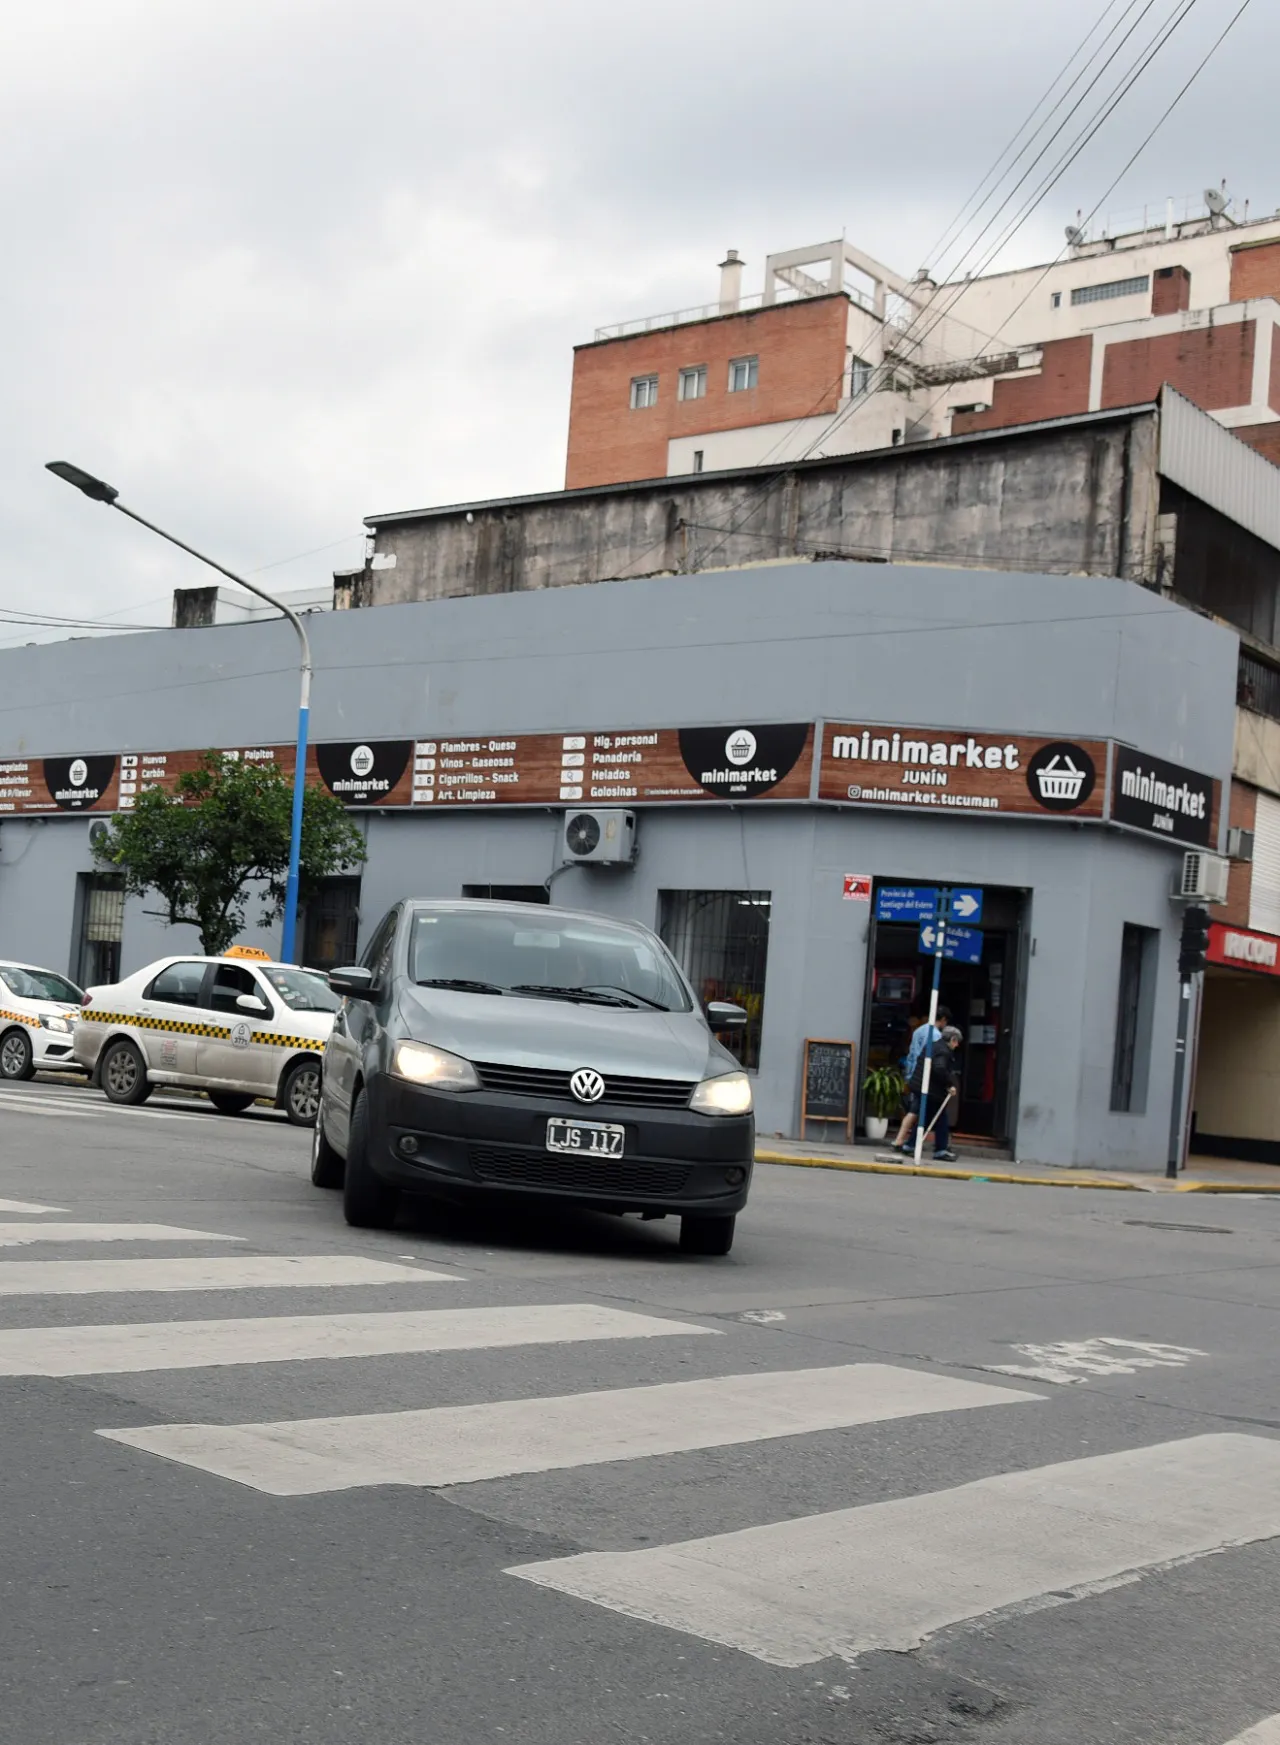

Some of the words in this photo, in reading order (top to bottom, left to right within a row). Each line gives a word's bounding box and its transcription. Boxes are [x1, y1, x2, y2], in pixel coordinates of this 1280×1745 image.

[440, 742, 480, 753] Fiambres
[489, 740, 517, 752] Queso
[593, 736, 613, 749] Hig.
[614, 733, 658, 748] personal
[832, 731, 1019, 770] minimarket
[142, 755, 167, 765] Huevos
[439, 757, 464, 769] Vinos
[472, 756, 514, 768] Gaseosas
[592, 751, 642, 764] Panadería
[141, 769, 166, 779] Carbón
[438, 773, 484, 787] Cigarrillos
[492, 771, 519, 784] Snack
[591, 769, 631, 781] Helados
[701, 767, 777, 784] minimarket
[902, 768, 948, 786] JUNÍN
[332, 777, 390, 792] minimarket
[55, 788, 100, 800] minimarket
[437, 790, 455, 800] Art.
[457, 788, 496, 801] Limpieza
[590, 786, 638, 798] Golosinas
[1121, 766, 1206, 819] minimarket
[880, 900, 904, 911] Santiago
[239, 947, 266, 957] TAXI
[549, 1126, 582, 1149] LJS
[589, 1131, 621, 1153] 117
